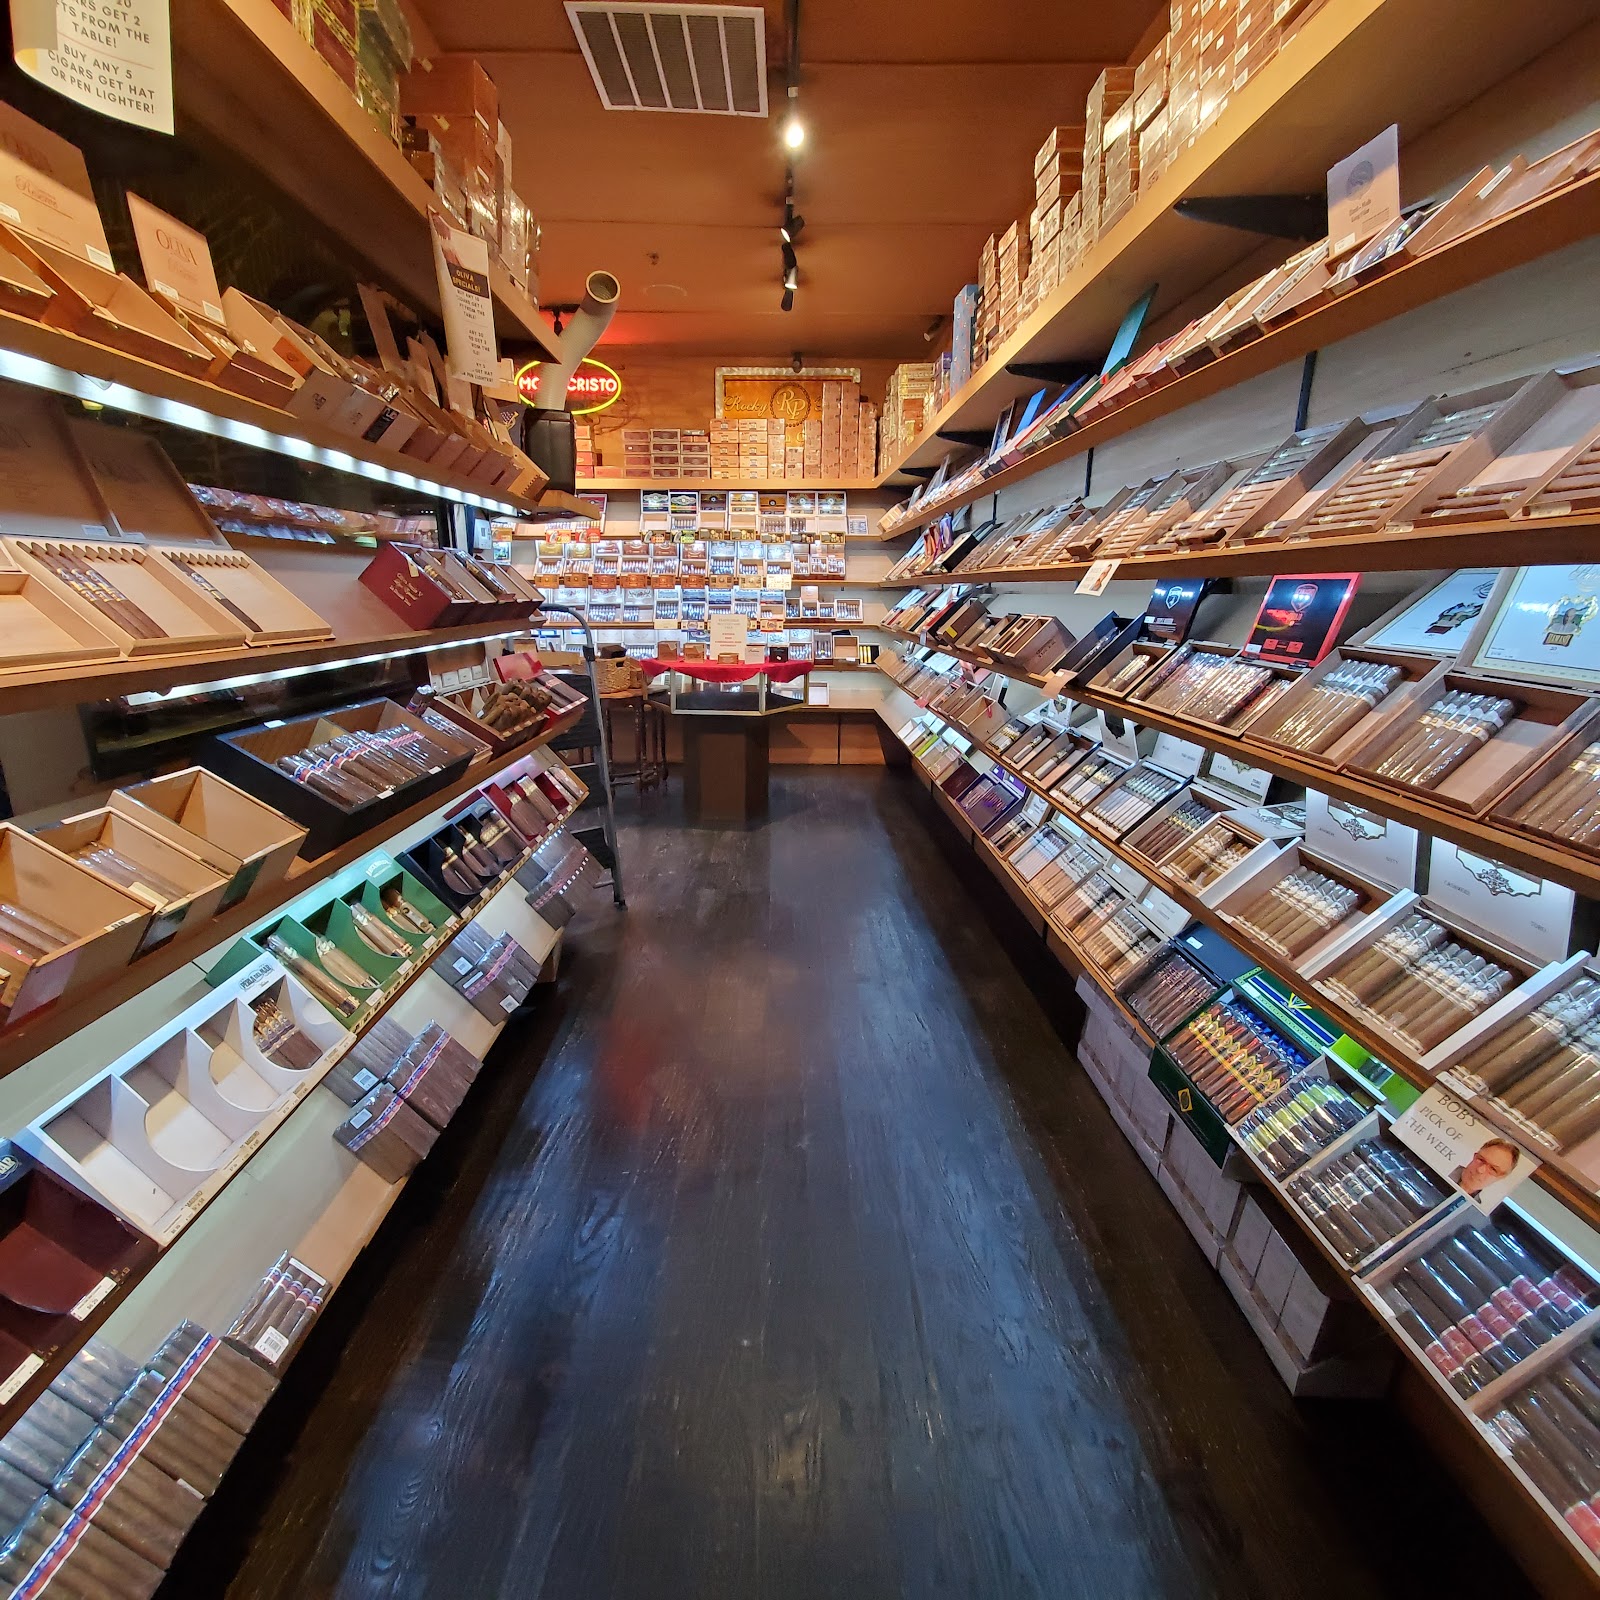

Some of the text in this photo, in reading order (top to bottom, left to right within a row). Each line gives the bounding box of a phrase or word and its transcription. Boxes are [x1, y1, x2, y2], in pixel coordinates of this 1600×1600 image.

[82, 12, 120, 35] FROM
[125, 27, 150, 44] THE
[102, 6, 128, 22] GET
[134, 16, 140, 26] 2
[72, 21, 116, 48] TABLE!
[48, 50, 155, 100] CIGARS GET HAT
[64, 44, 132, 79] BUY ANY 5
[51, 66, 155, 114] OR PEN LIGHTER!
[456, 270, 474, 282] OLIVA
[519, 377, 617, 392] MOCRISTO
[723, 395, 769, 416] Rocky
[1420, 1106, 1463, 1141] PICK OF
[1437, 1094, 1476, 1127] BOB'S
[1405, 1117, 1456, 1161] THE WEEK
